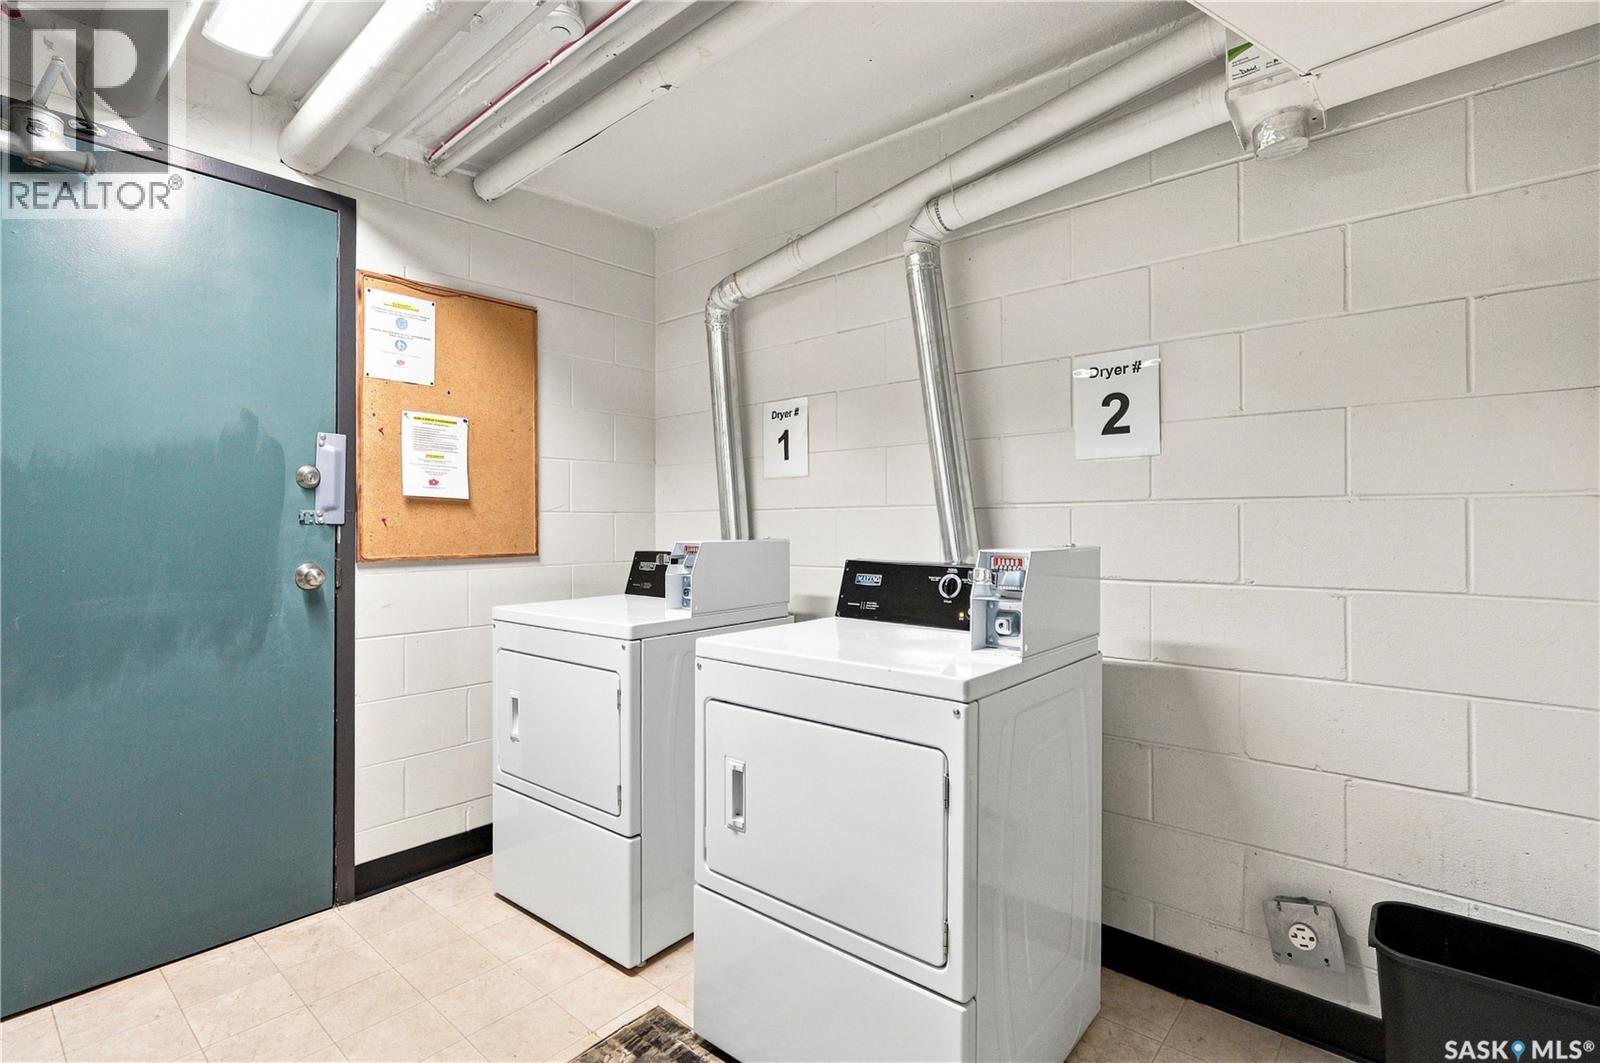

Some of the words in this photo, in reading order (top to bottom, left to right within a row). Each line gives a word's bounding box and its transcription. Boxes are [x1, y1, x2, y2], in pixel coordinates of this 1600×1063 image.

[1088, 364, 1129, 380] Dryer
[1132, 360, 1142, 373] #
[771, 410, 792, 421] Dryer
[794, 407, 800, 416] #
[1101, 392, 1131, 436] 2
[778, 429, 789, 461] 1
